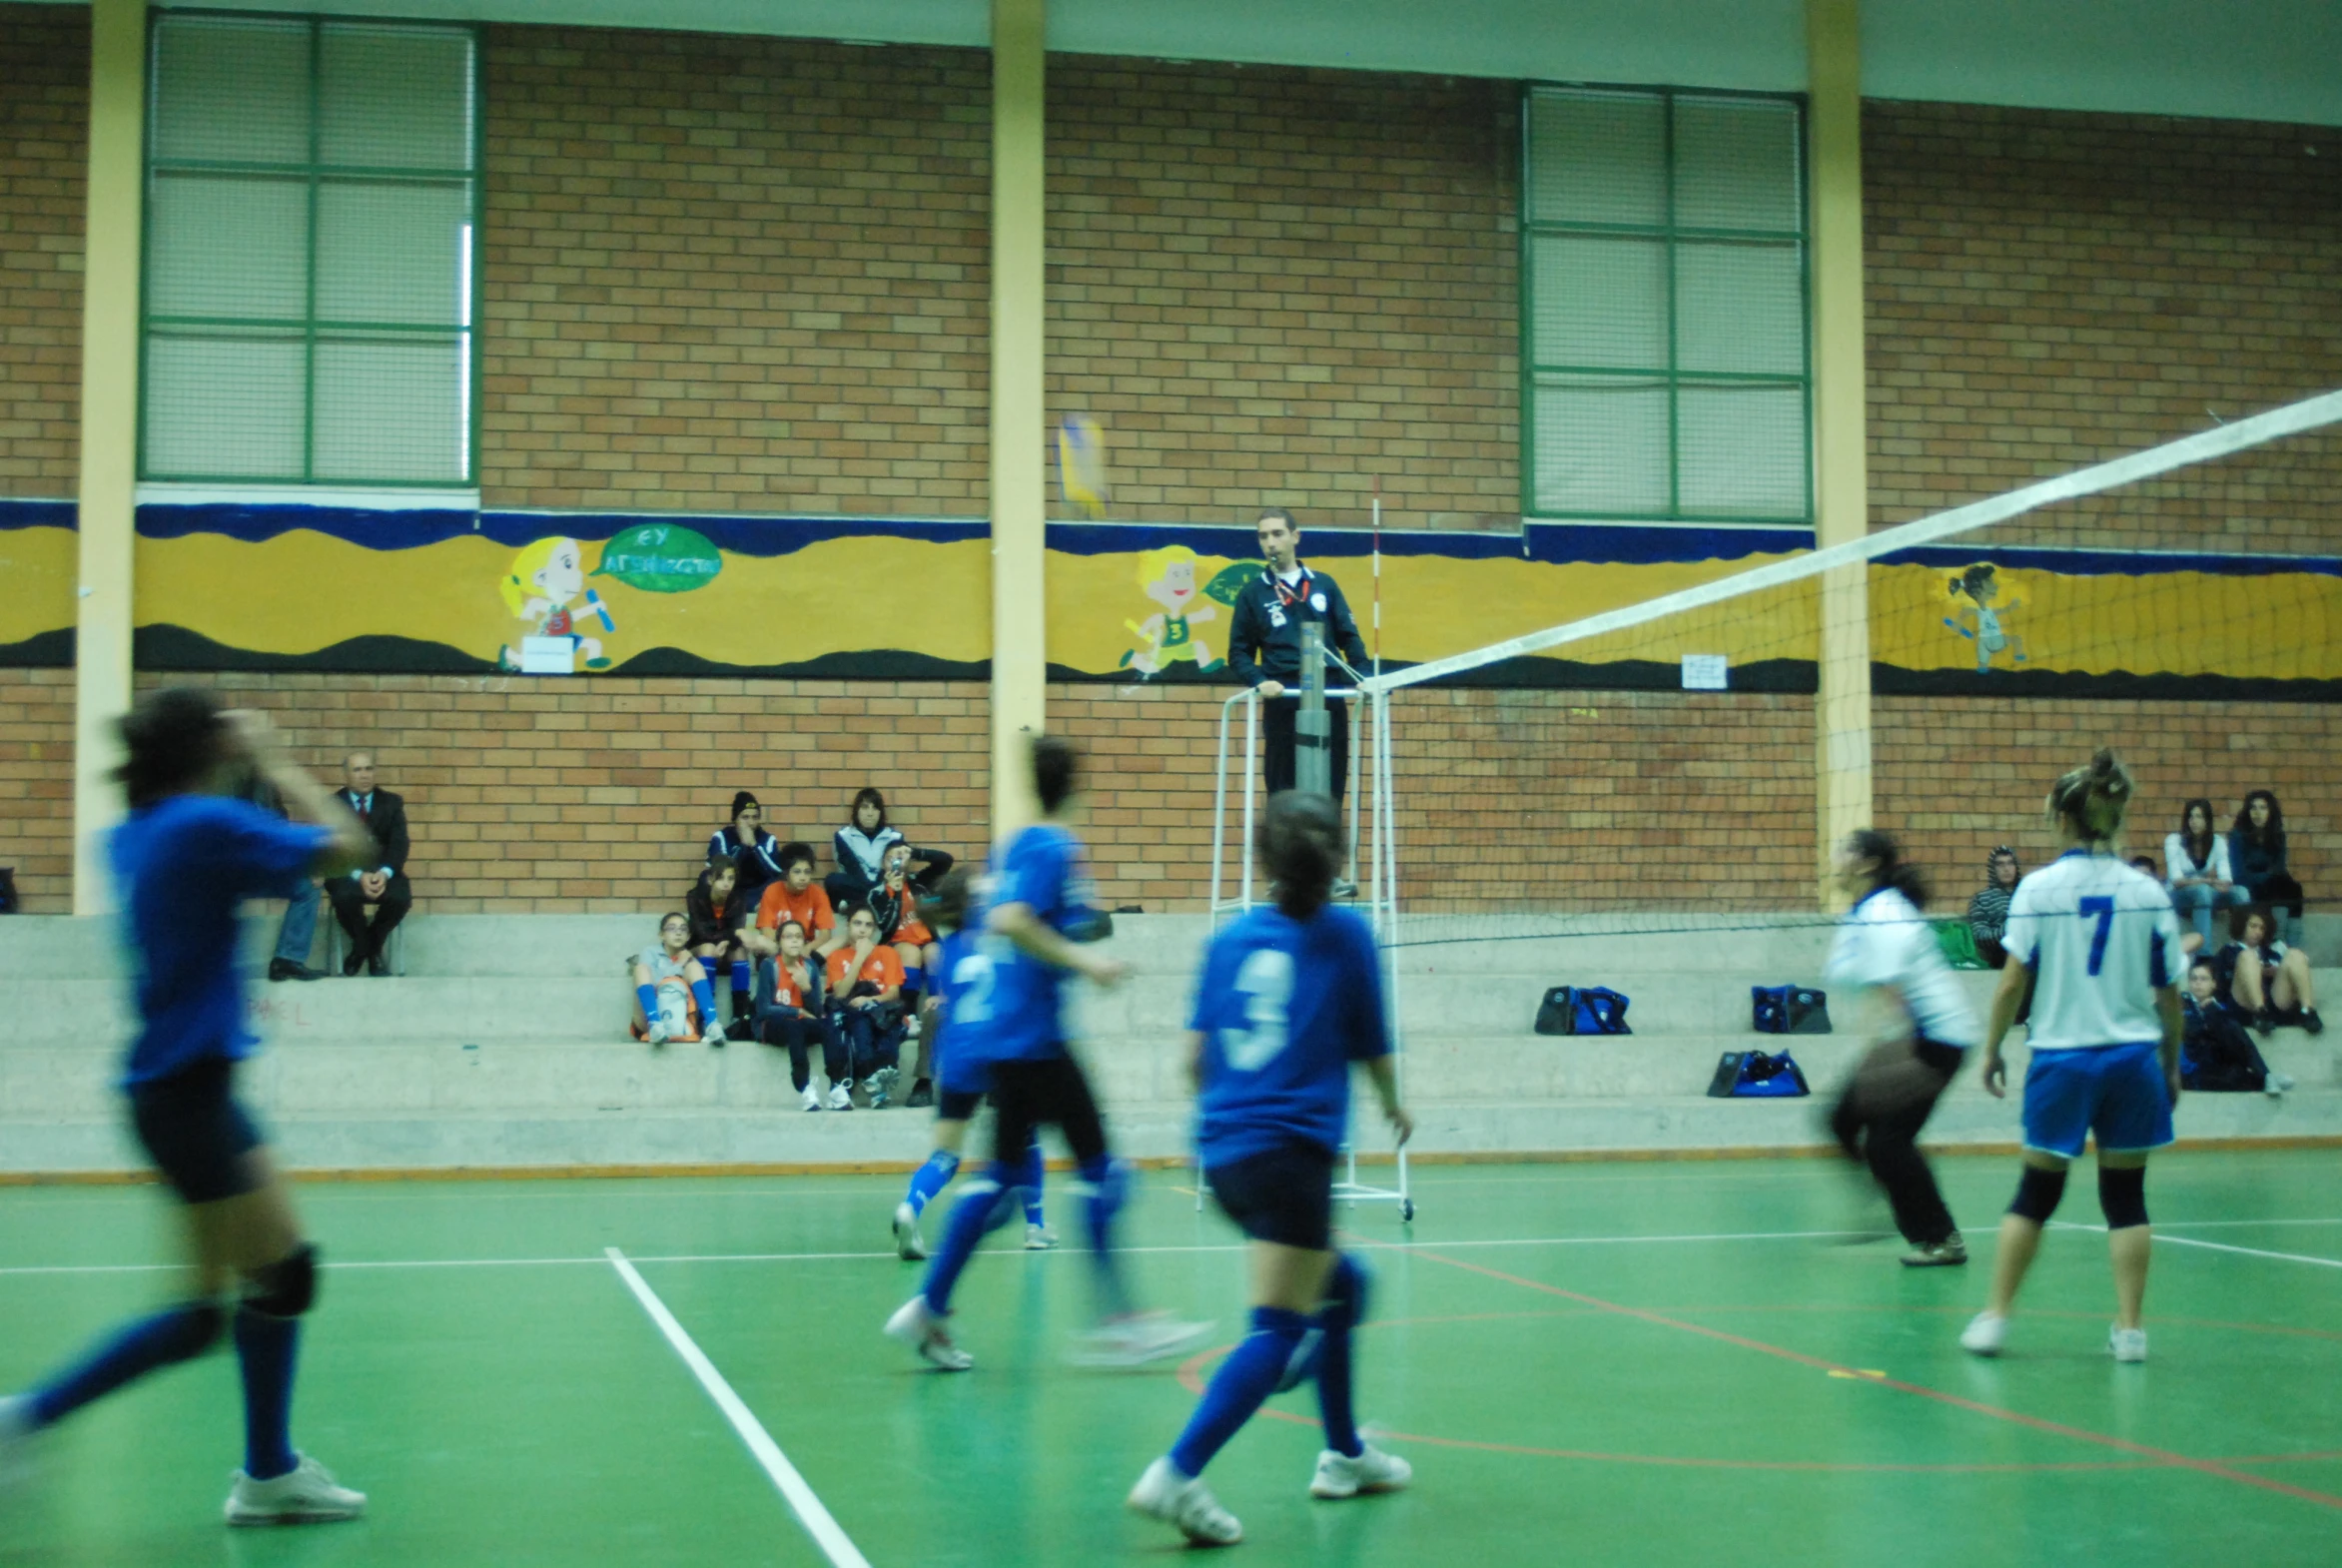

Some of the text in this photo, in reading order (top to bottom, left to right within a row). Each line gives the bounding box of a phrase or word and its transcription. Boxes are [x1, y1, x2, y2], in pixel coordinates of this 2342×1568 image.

[1170, 623, 1183, 639] 3
[2078, 896, 2113, 977] 7
[952, 954, 995, 1025] 2
[1219, 949, 1296, 1072] 3
